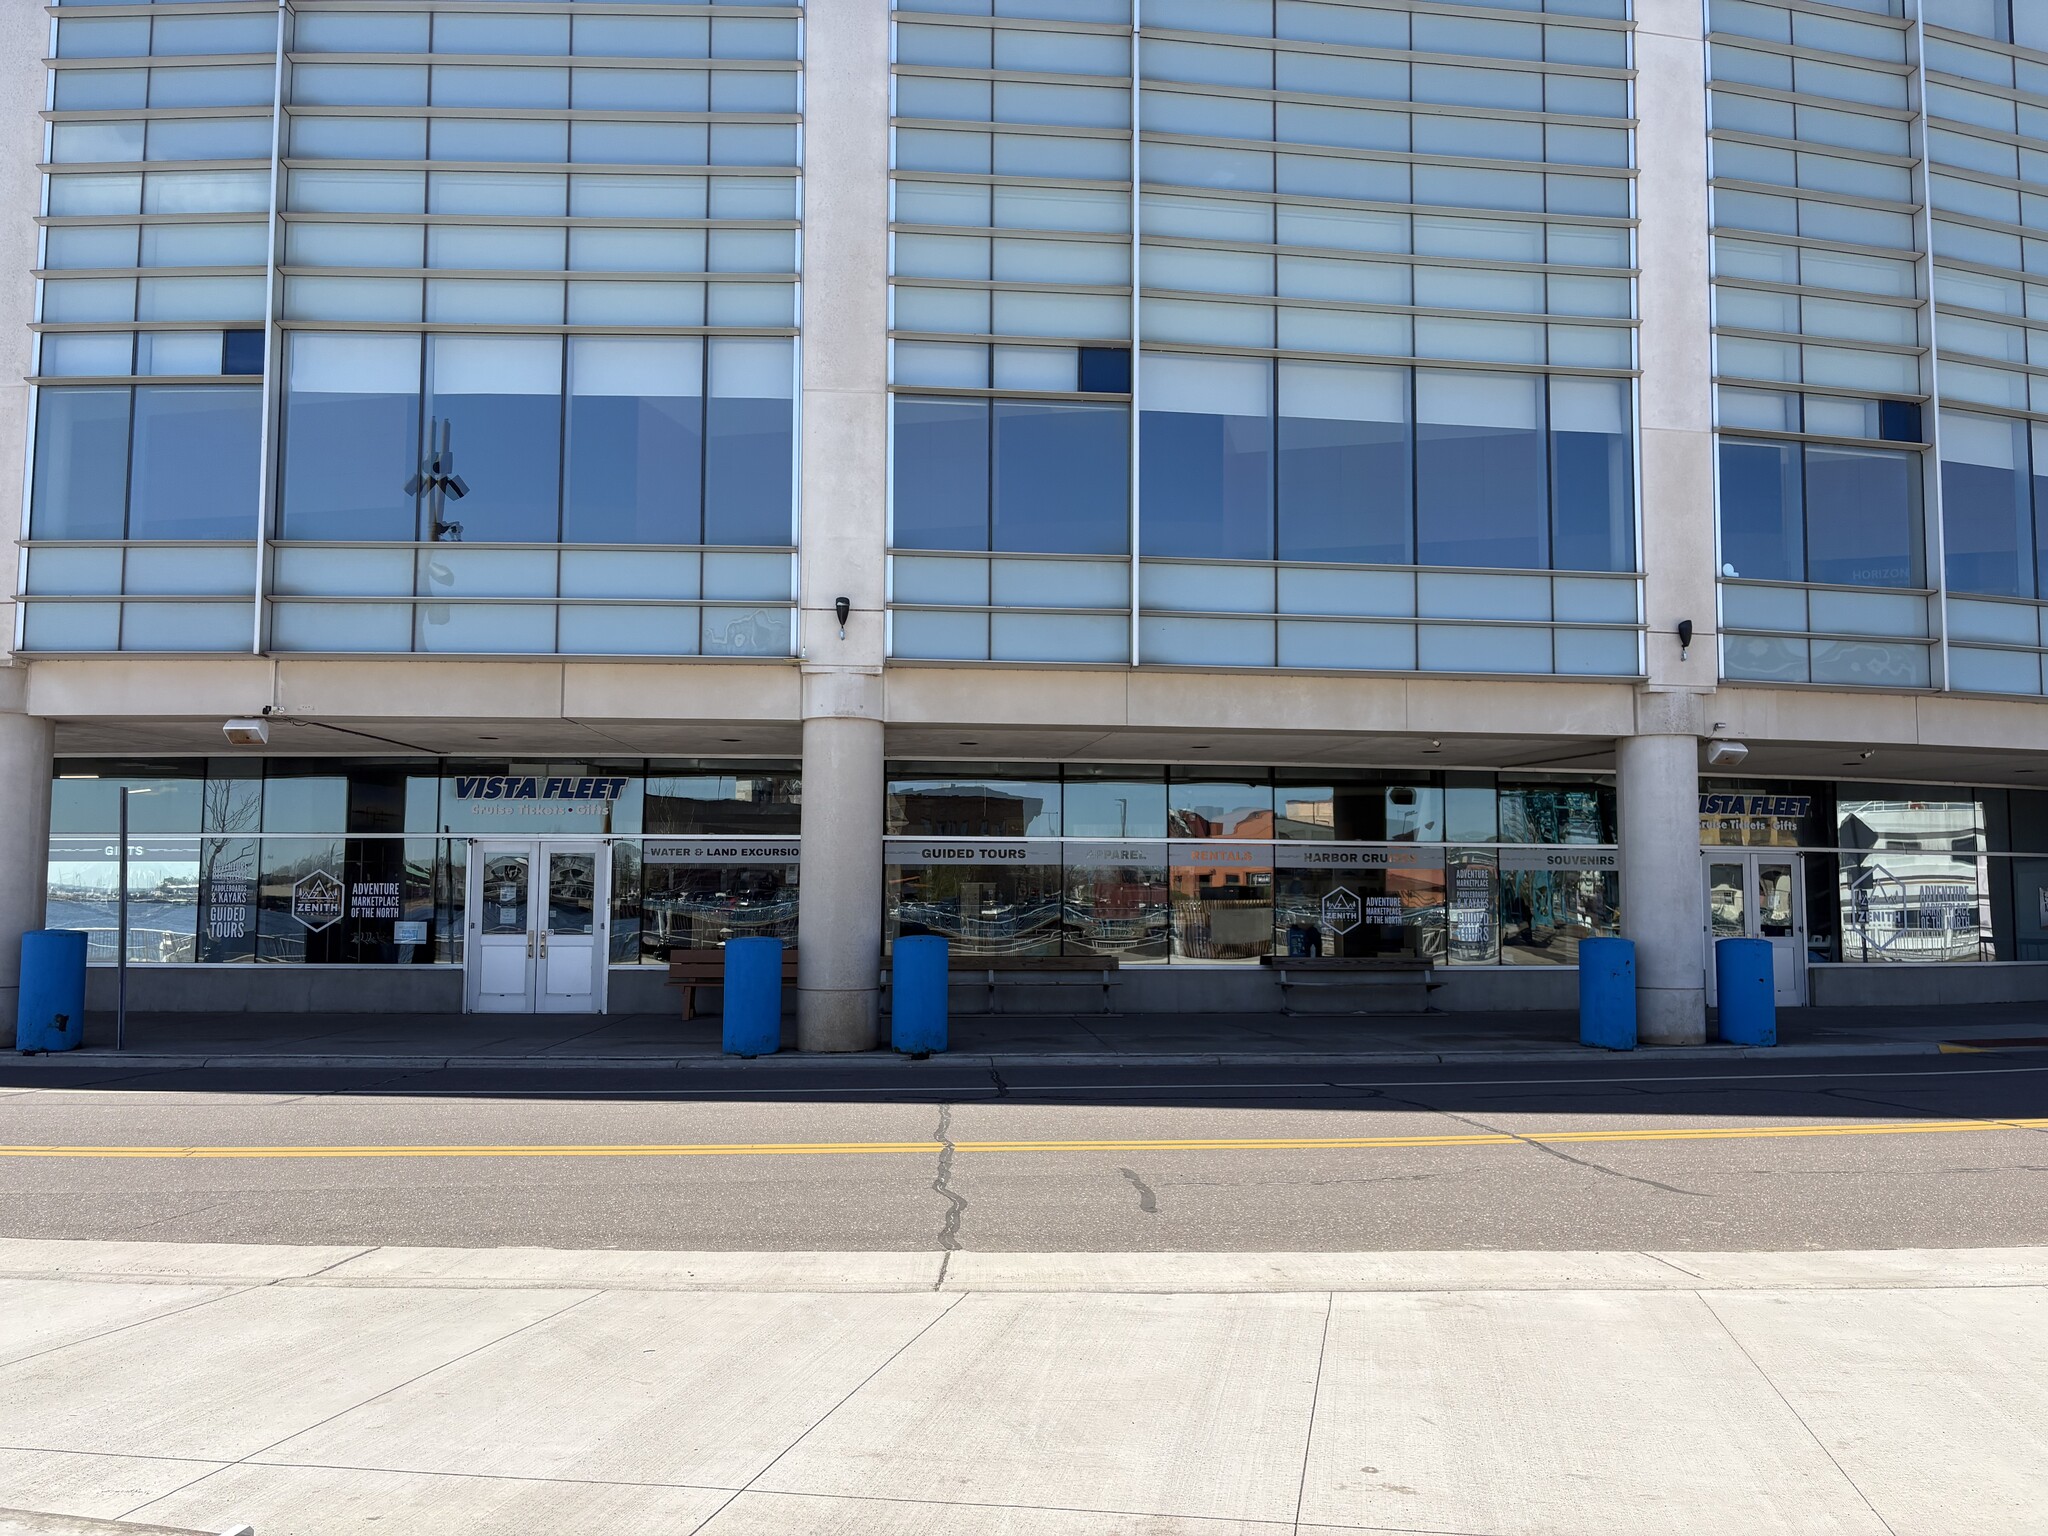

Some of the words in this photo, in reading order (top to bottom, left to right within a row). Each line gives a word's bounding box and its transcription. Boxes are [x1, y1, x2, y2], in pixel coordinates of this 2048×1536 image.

[454, 776, 539, 800] VISTA
[542, 776, 629, 800] FLEET
[471, 804, 514, 816] Cruise
[518, 804, 565, 816] Tickets
[576, 804, 610, 816] Gifts
[1699, 793, 1746, 816] ISTA
[1749, 794, 1811, 817] FLEET
[1730, 820, 1766, 830] Tickets
[1773, 820, 1798, 831] Gifts
[105, 845, 143, 856] GITS
[650, 848, 691, 857] WATER
[694, 848, 703, 857] &
[706, 848, 738, 857] LAND
[921, 848, 975, 859] GUIDED
[979, 849, 1027, 859] TOURS
[1086, 850, 1147, 860] APPAREL
[1190, 850, 1253, 861] RENTALS
[1303, 852, 1358, 863] HARBOR
[1547, 855, 1615, 866] SOUVENIRS
[1456, 869, 1489, 879] ADVENTURE
[211, 884, 248, 892] PADDLEBOARDS
[352, 882, 400, 895] ADVENTURE
[1456, 879, 1489, 888] MARKETPLACE
[210, 893, 217, 903] &
[218, 892, 247, 903] KAYAKS
[1919, 885, 1969, 902] ADVENTURE
[351, 896, 400, 907] MARKETPLACE
[1366, 896, 1401, 906] ADVENTURE
[297, 903, 338, 912] ZENITH
[351, 908, 360, 918] OF
[361, 908, 375, 918] THE
[376, 908, 399, 918] NORTH
[1366, 907, 1402, 916] MARKETPLACE
[210, 906, 246, 921] GUIDED
[1858, 911, 1901, 923] ZENITH
[1365, 916, 1373, 925] OF
[1374, 916, 1384, 925] THE
[1385, 916, 1402, 926] NORTH
[210, 922, 245, 938] TOURS
